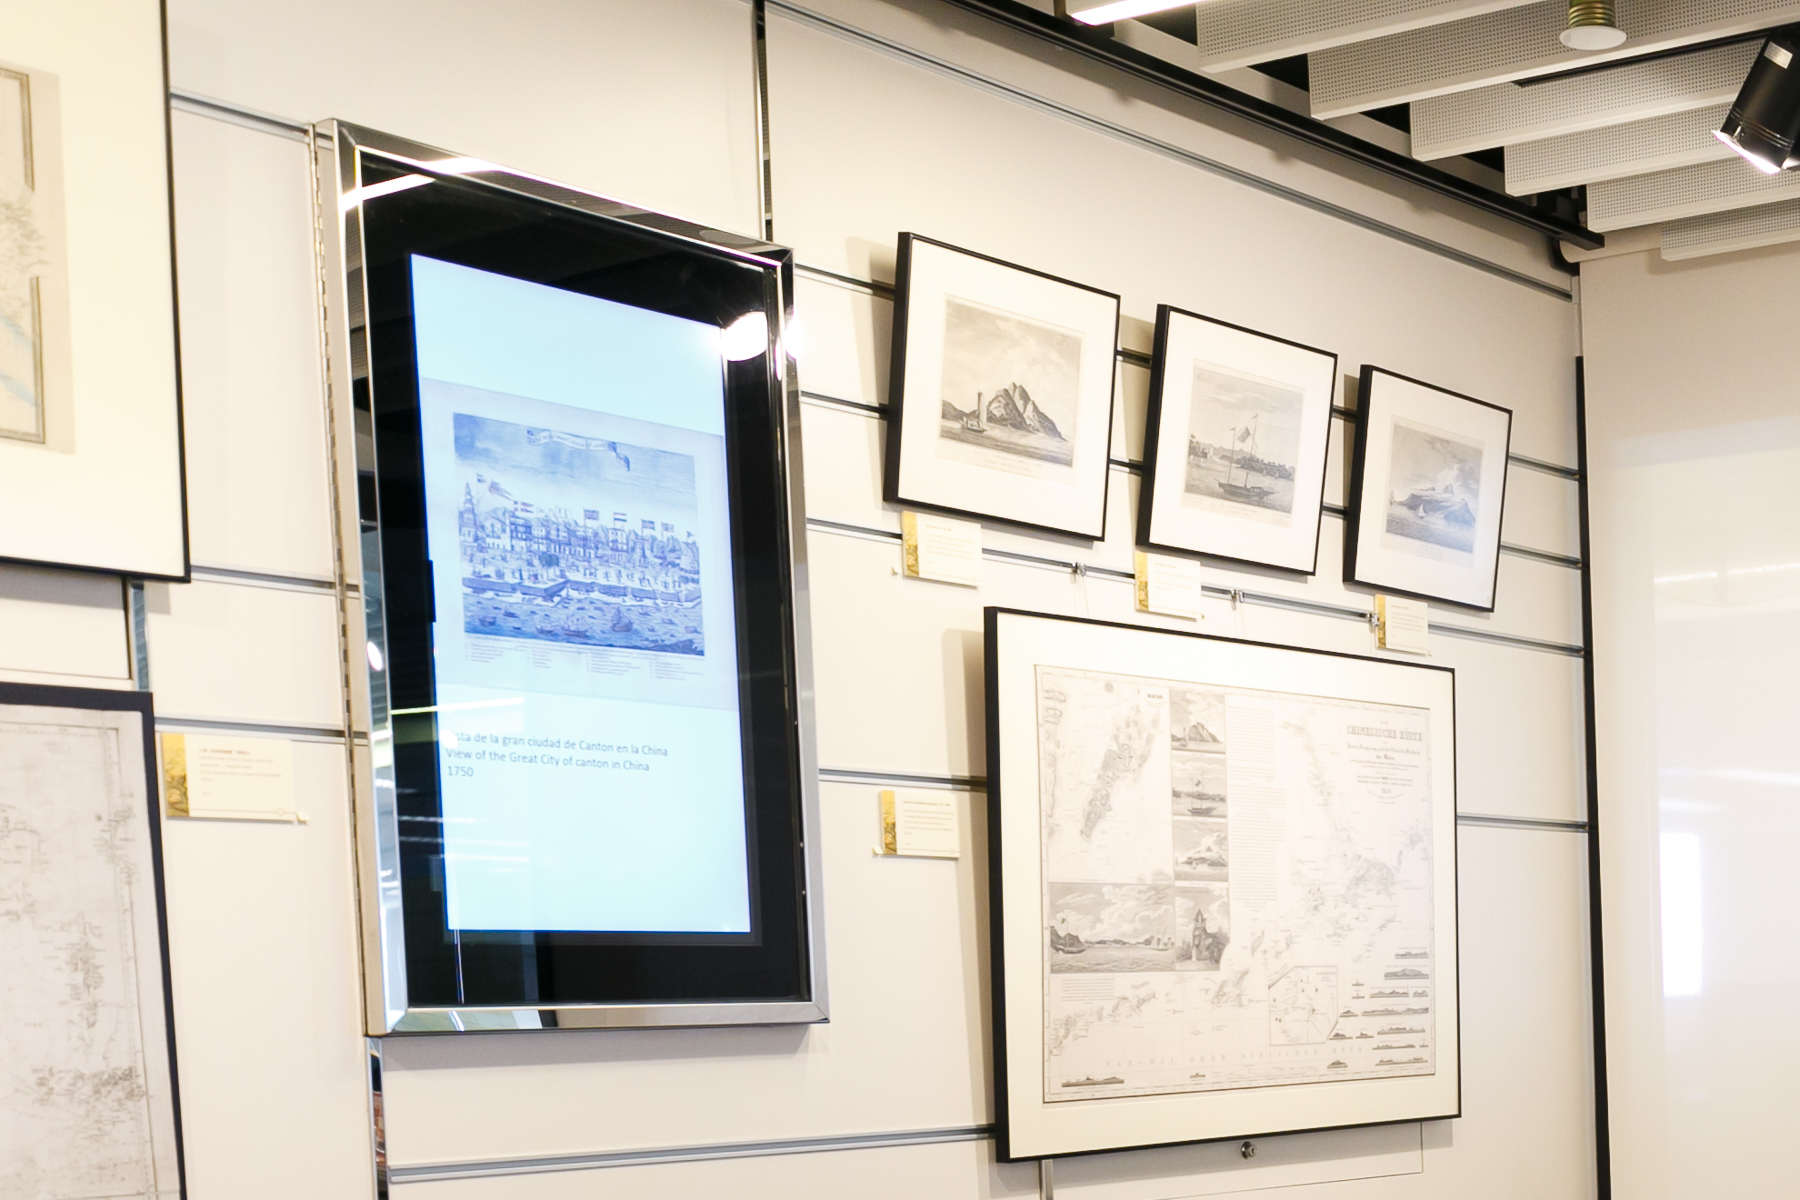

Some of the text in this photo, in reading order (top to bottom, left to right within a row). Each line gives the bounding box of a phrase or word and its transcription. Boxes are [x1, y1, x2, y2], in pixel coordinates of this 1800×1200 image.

[474, 733, 487, 743] de
[490, 733, 499, 744] la
[502, 736, 525, 747] gran
[527, 736, 561, 749] ciudad
[563, 739, 576, 749] de
[578, 740, 614, 752] Canton
[616, 744, 629, 754] en
[631, 744, 639, 755] la
[641, 744, 668, 756] China
[445, 747, 650, 771] View of the Great City of canton in China
[447, 765, 474, 777] 1750
